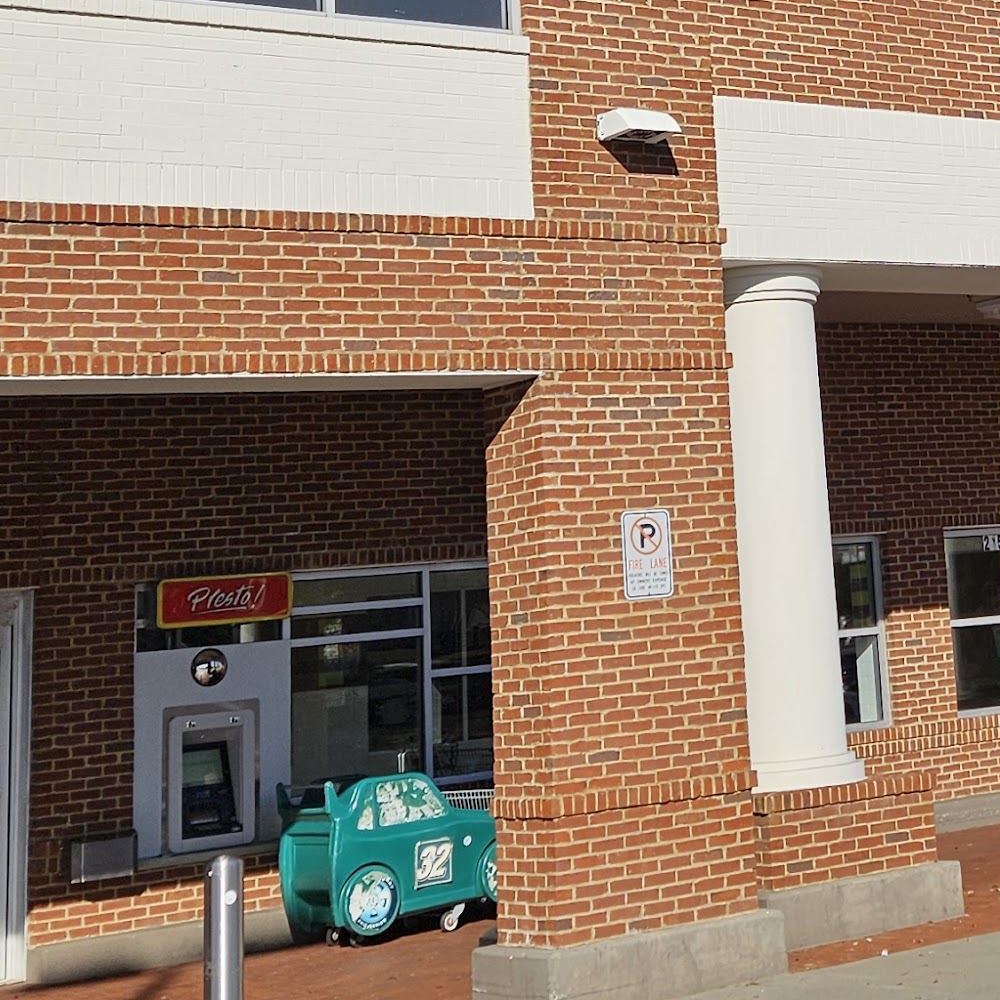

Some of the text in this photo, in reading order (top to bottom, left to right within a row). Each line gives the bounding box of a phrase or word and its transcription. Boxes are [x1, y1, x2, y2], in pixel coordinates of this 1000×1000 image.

[629, 557, 668, 571] FIRE LANE
[187, 583, 266, 612] Presto!
[416, 842, 452, 882] 32
